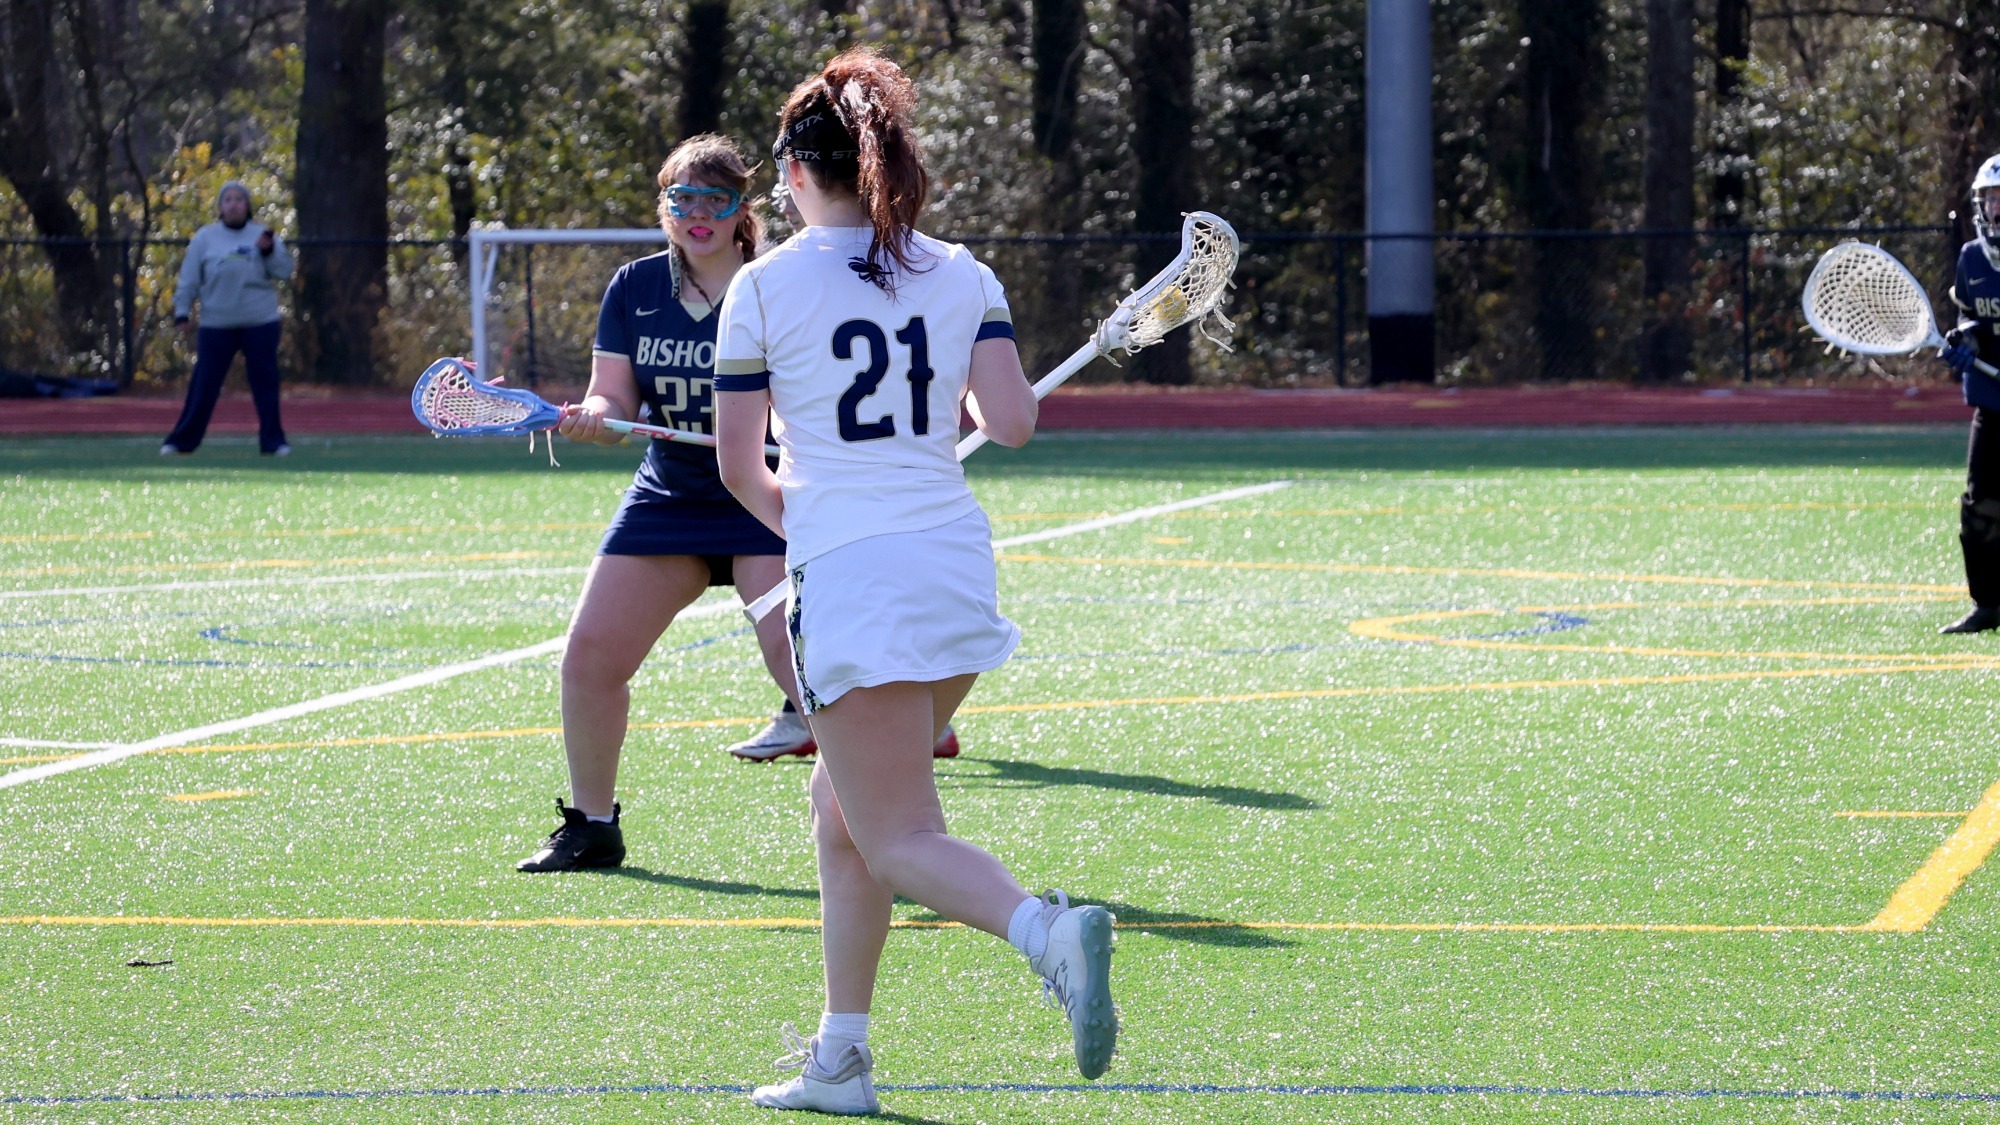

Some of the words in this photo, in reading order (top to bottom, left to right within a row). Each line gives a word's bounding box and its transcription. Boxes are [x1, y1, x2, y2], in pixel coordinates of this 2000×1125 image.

[795, 112, 824, 134] STX
[794, 150, 821, 160] STX
[636, 336, 716, 369] BISHO
[830, 315, 936, 443] 21
[655, 376, 716, 436] 23
